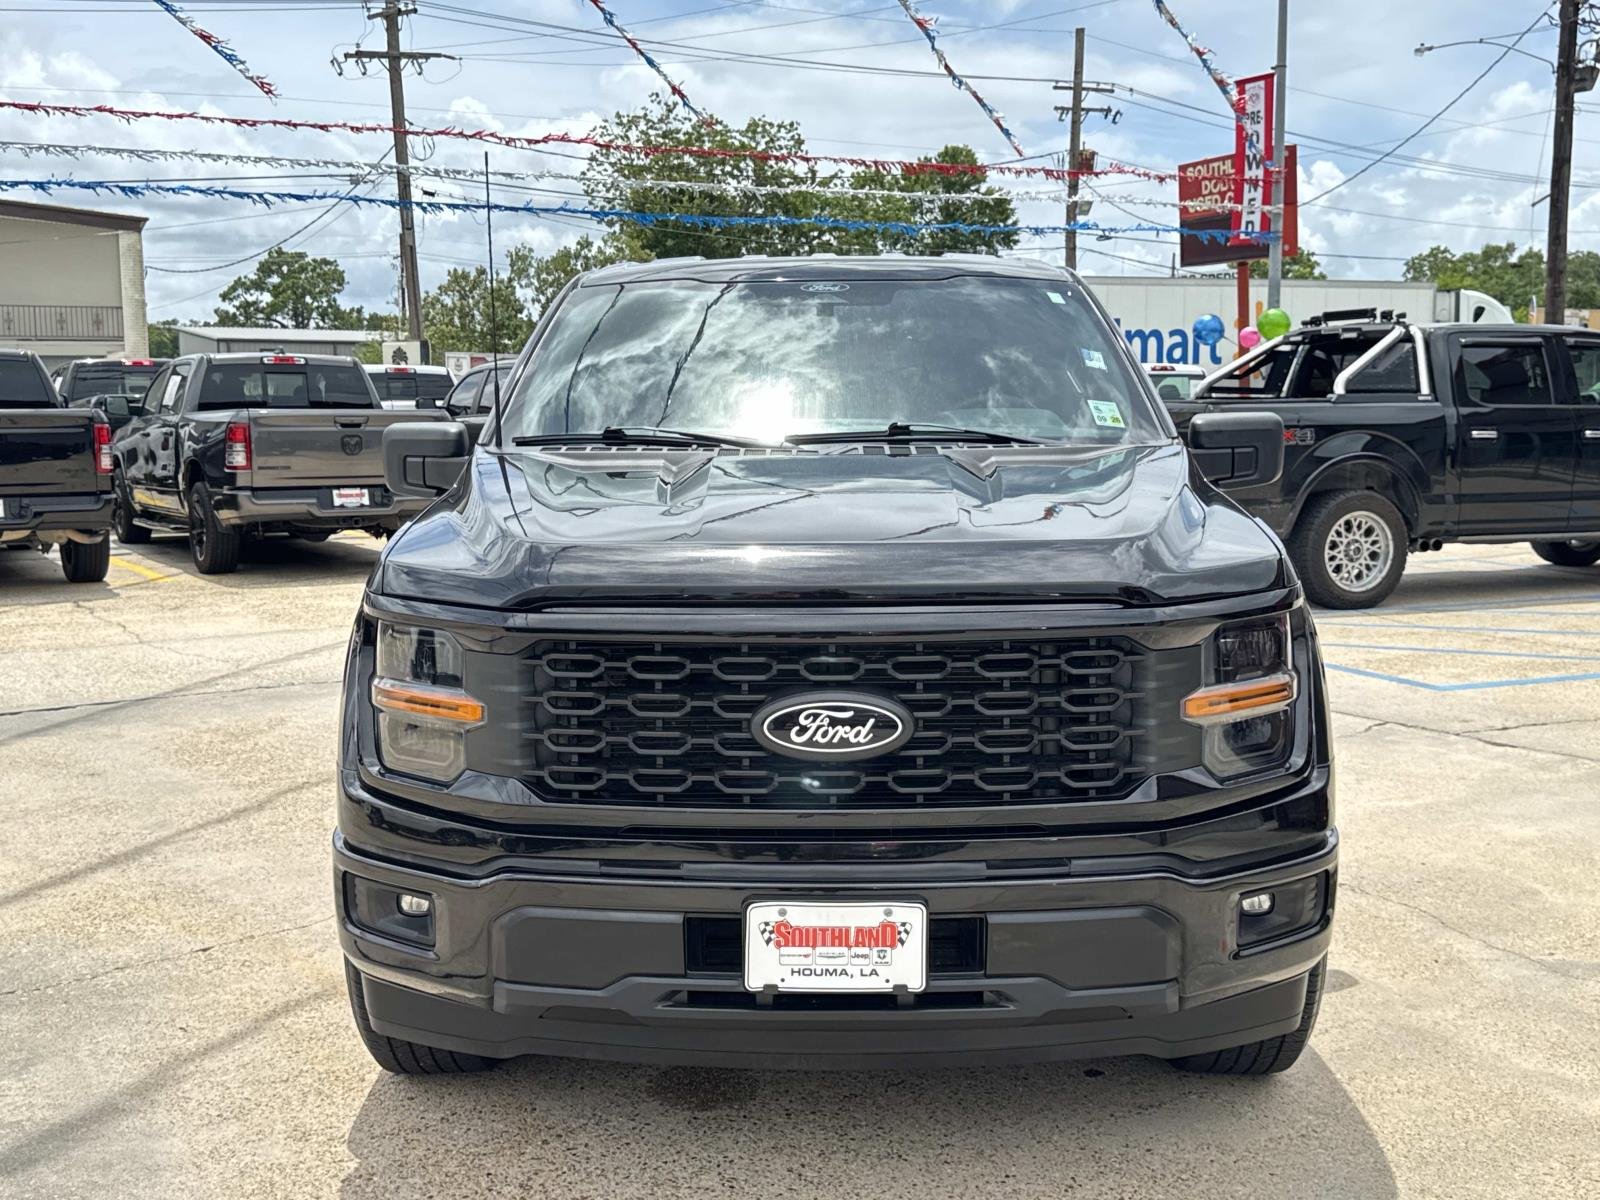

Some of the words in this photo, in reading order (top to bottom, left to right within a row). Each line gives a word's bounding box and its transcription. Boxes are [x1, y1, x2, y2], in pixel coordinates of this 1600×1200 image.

[789, 708, 876, 744] Ford
[774, 919, 899, 949] SOUTHLAND
[850, 951, 870, 960] Jeep
[790, 967, 855, 979] HOUMA,
[860, 967, 880, 977] LA
